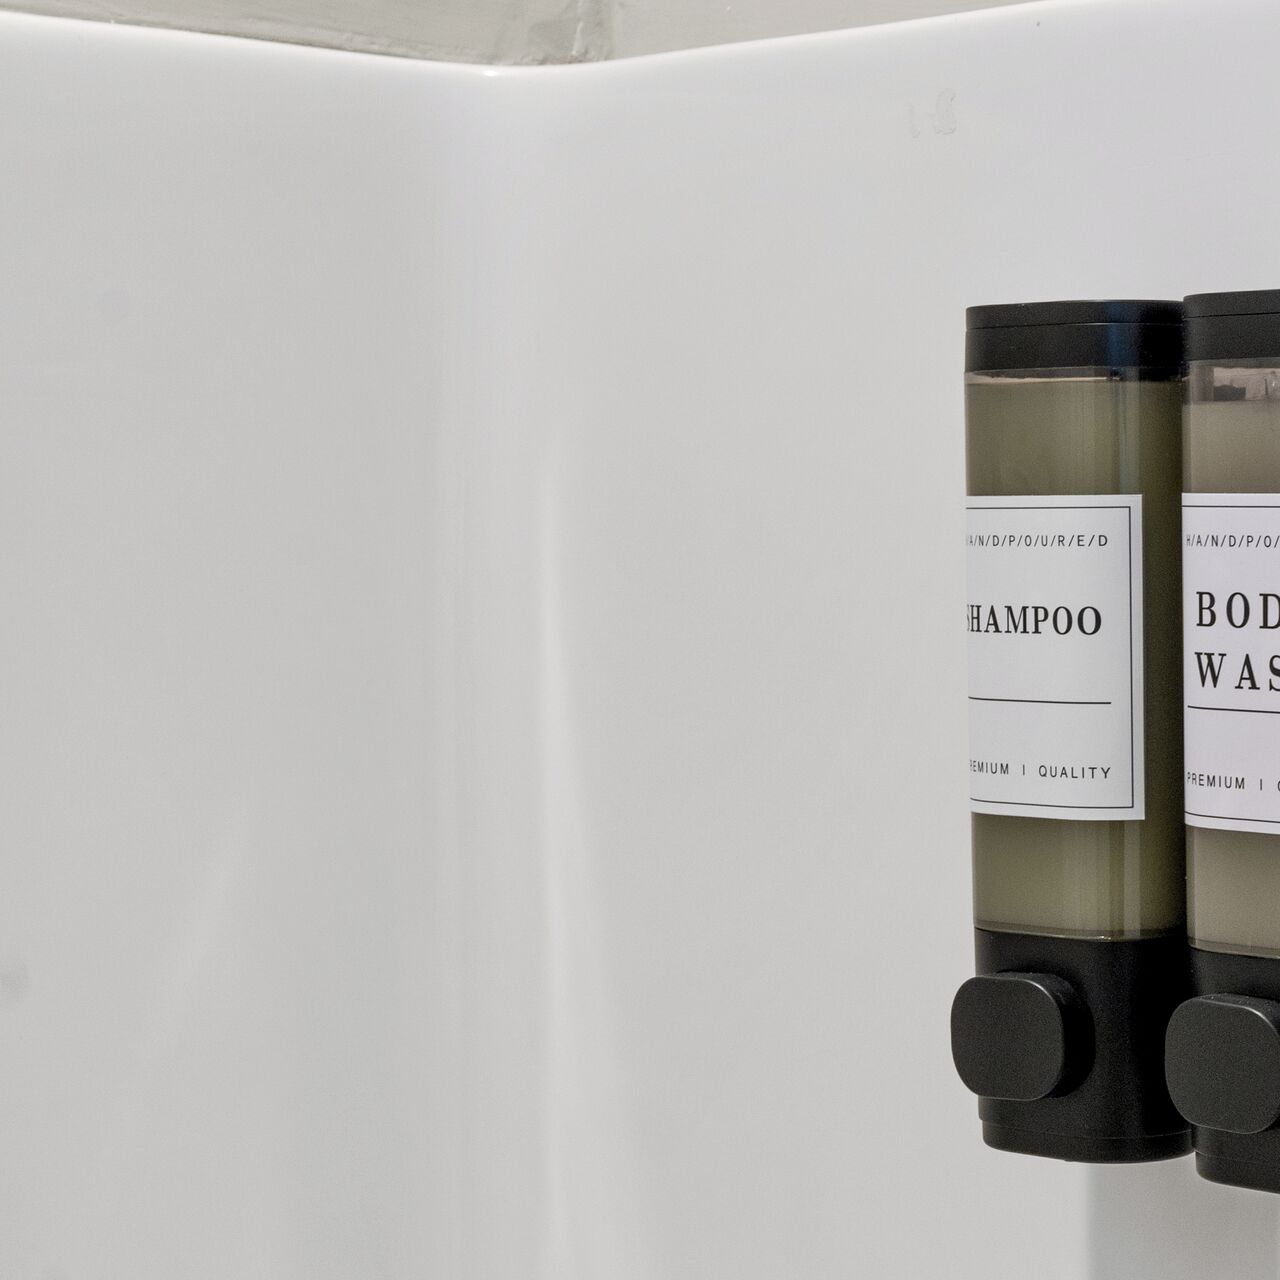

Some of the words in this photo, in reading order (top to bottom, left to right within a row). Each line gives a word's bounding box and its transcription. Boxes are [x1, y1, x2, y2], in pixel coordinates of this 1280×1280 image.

[967, 534, 1109, 548] A/N/D/P/O/U/R/E/D
[1038, 764, 1112, 780] QUALITY
[1187, 771, 1246, 790] PREMIUM
